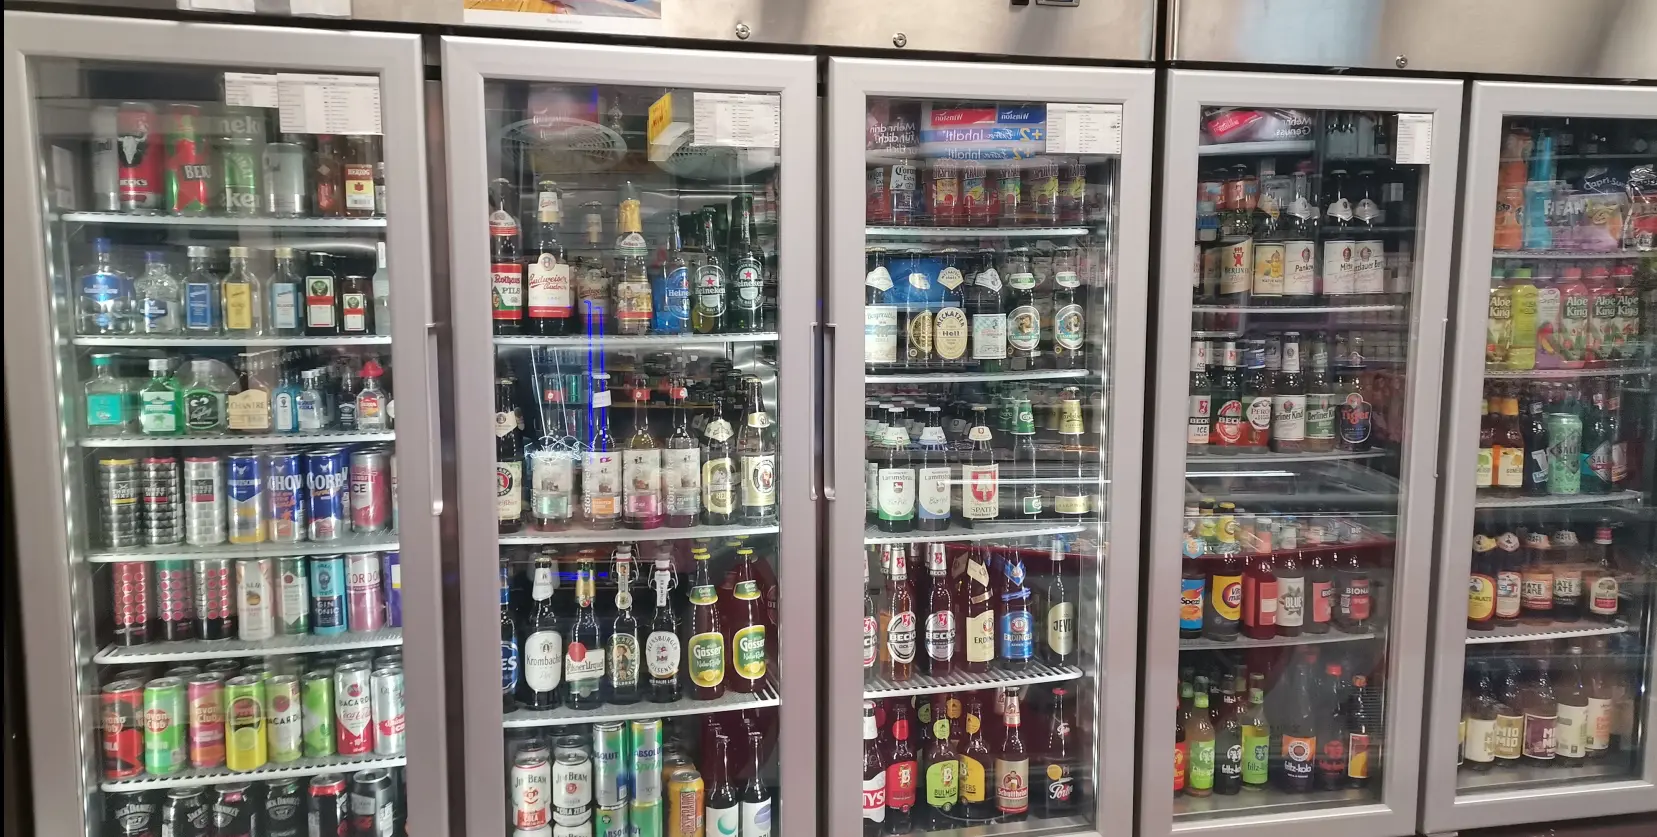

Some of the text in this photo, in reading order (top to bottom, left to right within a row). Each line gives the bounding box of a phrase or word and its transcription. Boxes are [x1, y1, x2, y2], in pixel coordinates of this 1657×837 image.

[1489, 296, 1511, 306] Aloe
[1566, 296, 1588, 306] Aloe
[1595, 296, 1616, 306] Aloe
[1617, 296, 1639, 306] Aloe
[1489, 306, 1511, 318] King
[1566, 306, 1588, 318] King
[1595, 306, 1616, 318] King
[1617, 306, 1639, 318] King
[936, 310, 965, 328] MECKATZER
[1342, 410, 1370, 425] Tiger
[693, 644, 722, 660] Gösser
[1284, 761, 1312, 773] fritz-kola
